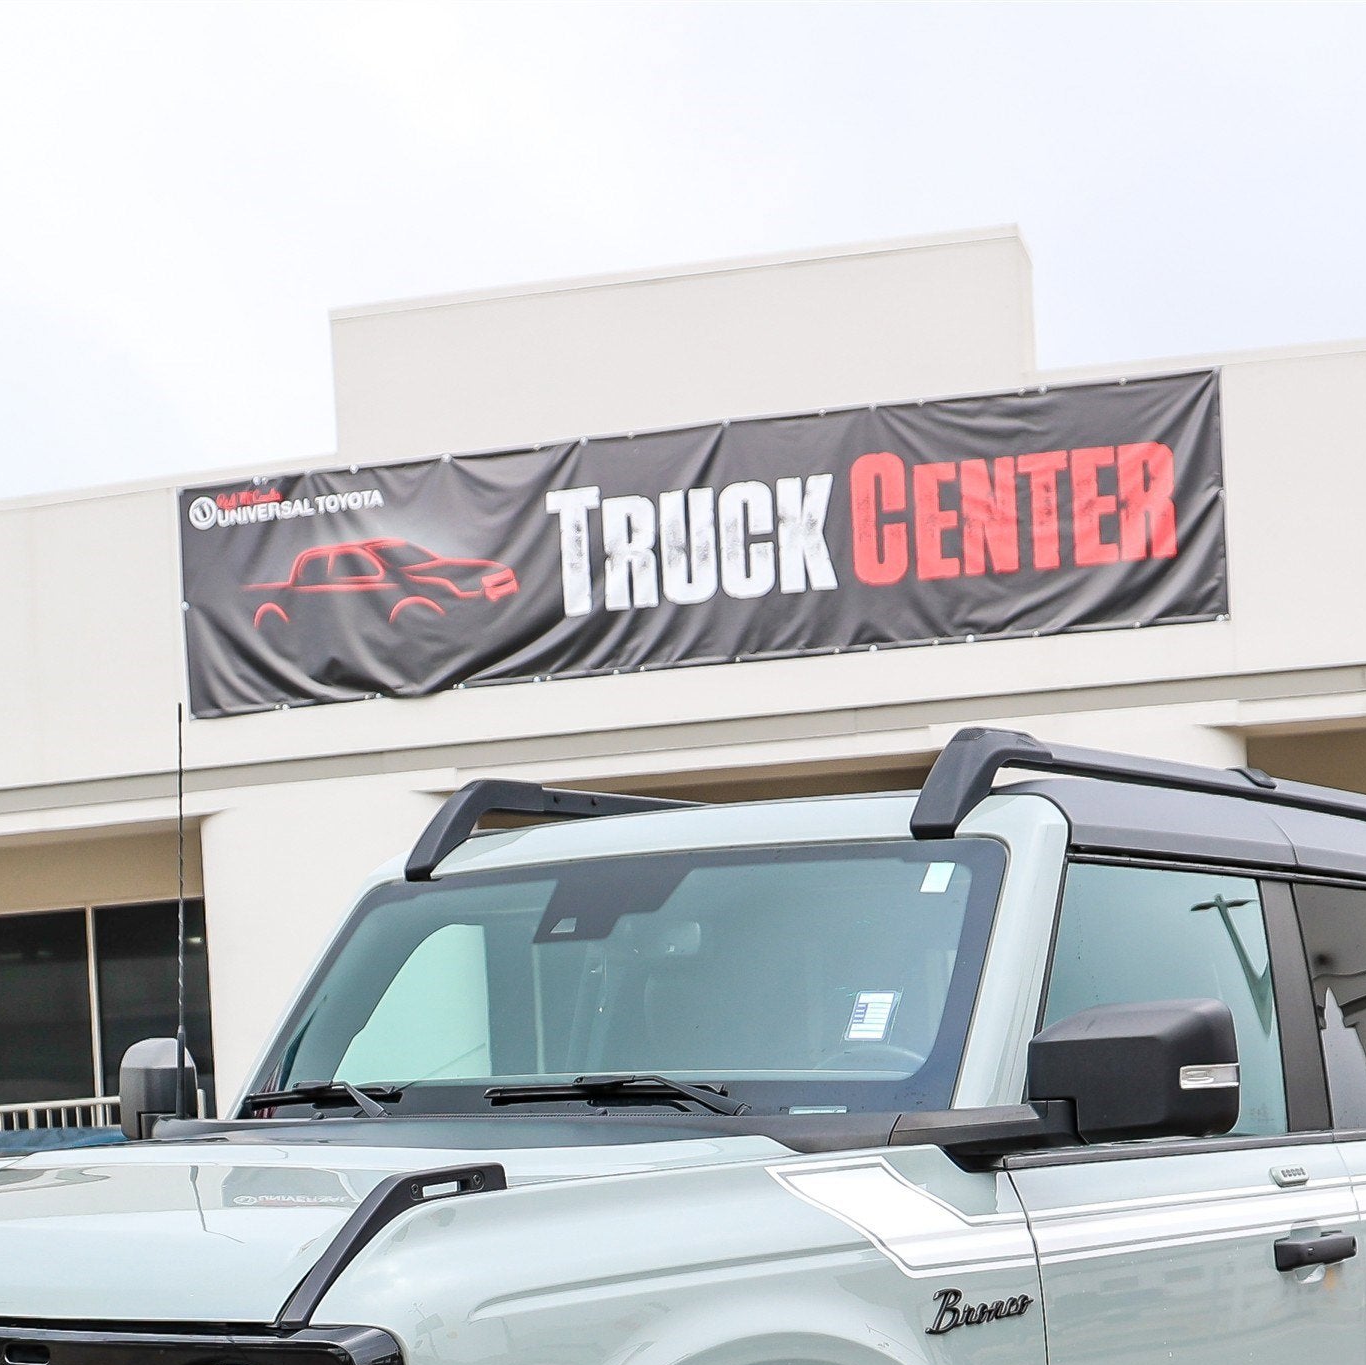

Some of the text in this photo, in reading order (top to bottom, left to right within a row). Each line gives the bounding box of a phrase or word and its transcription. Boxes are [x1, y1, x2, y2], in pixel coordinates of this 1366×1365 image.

[217, 489, 385, 527] UNIVERSAL TOYOTA
[546, 441, 1178, 618] TRUCK CENTER
[925, 1288, 1034, 1334] Bronco
